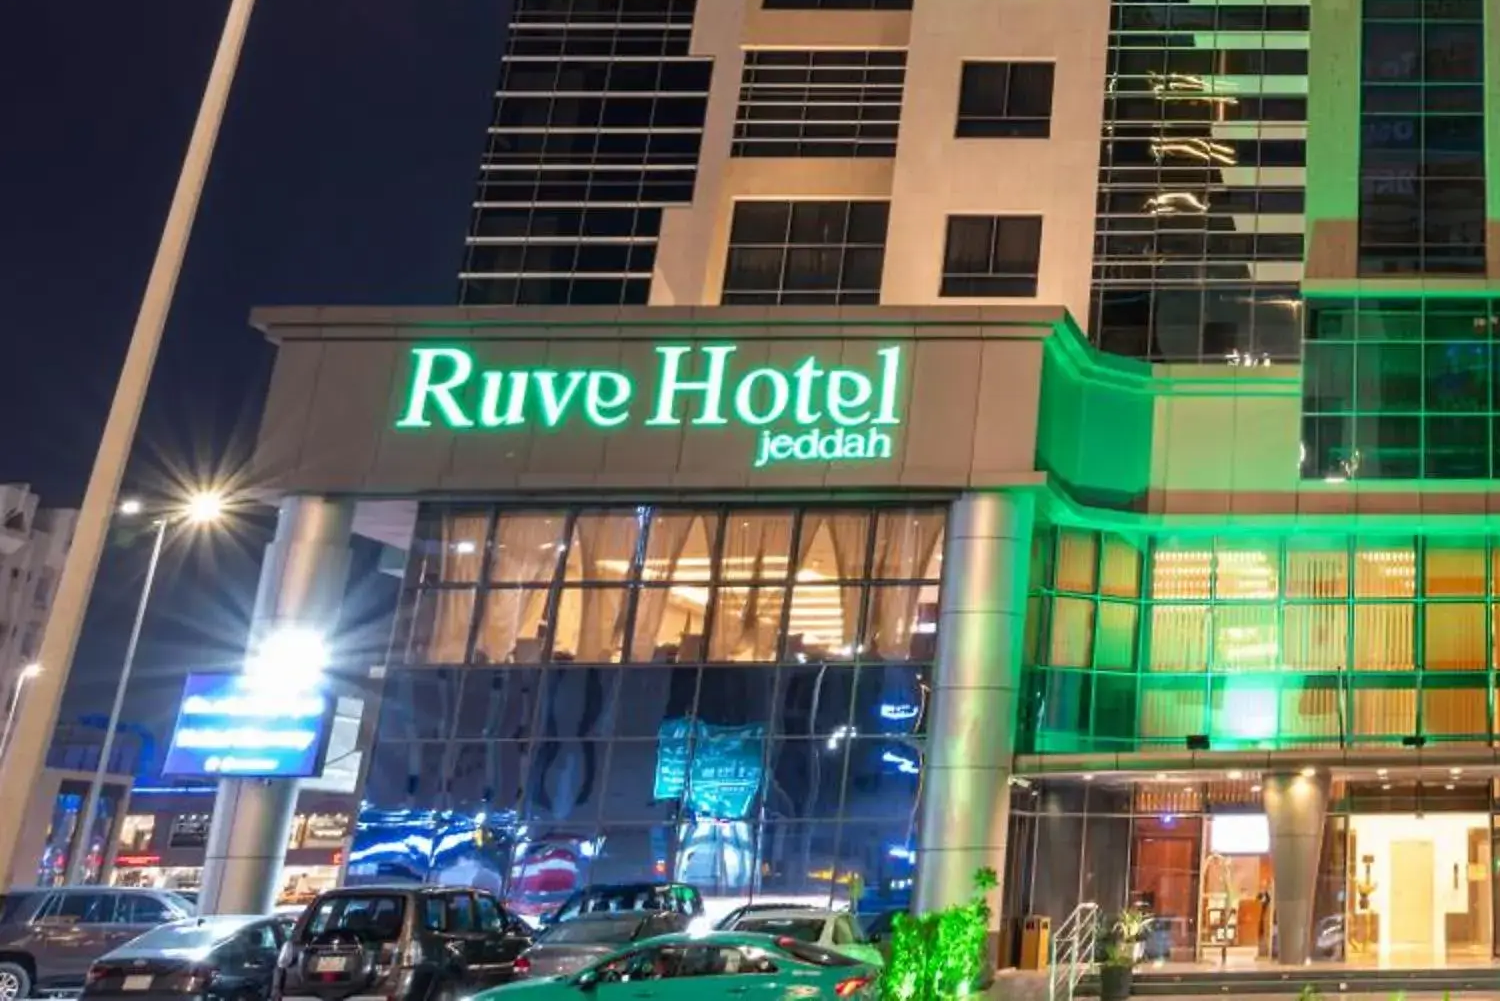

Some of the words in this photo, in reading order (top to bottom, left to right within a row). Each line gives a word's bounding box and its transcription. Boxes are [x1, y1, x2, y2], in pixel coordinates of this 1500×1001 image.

[396, 346, 632, 427] Ruve
[645, 345, 901, 426] Hotel
[754, 426, 892, 467] jeddah
